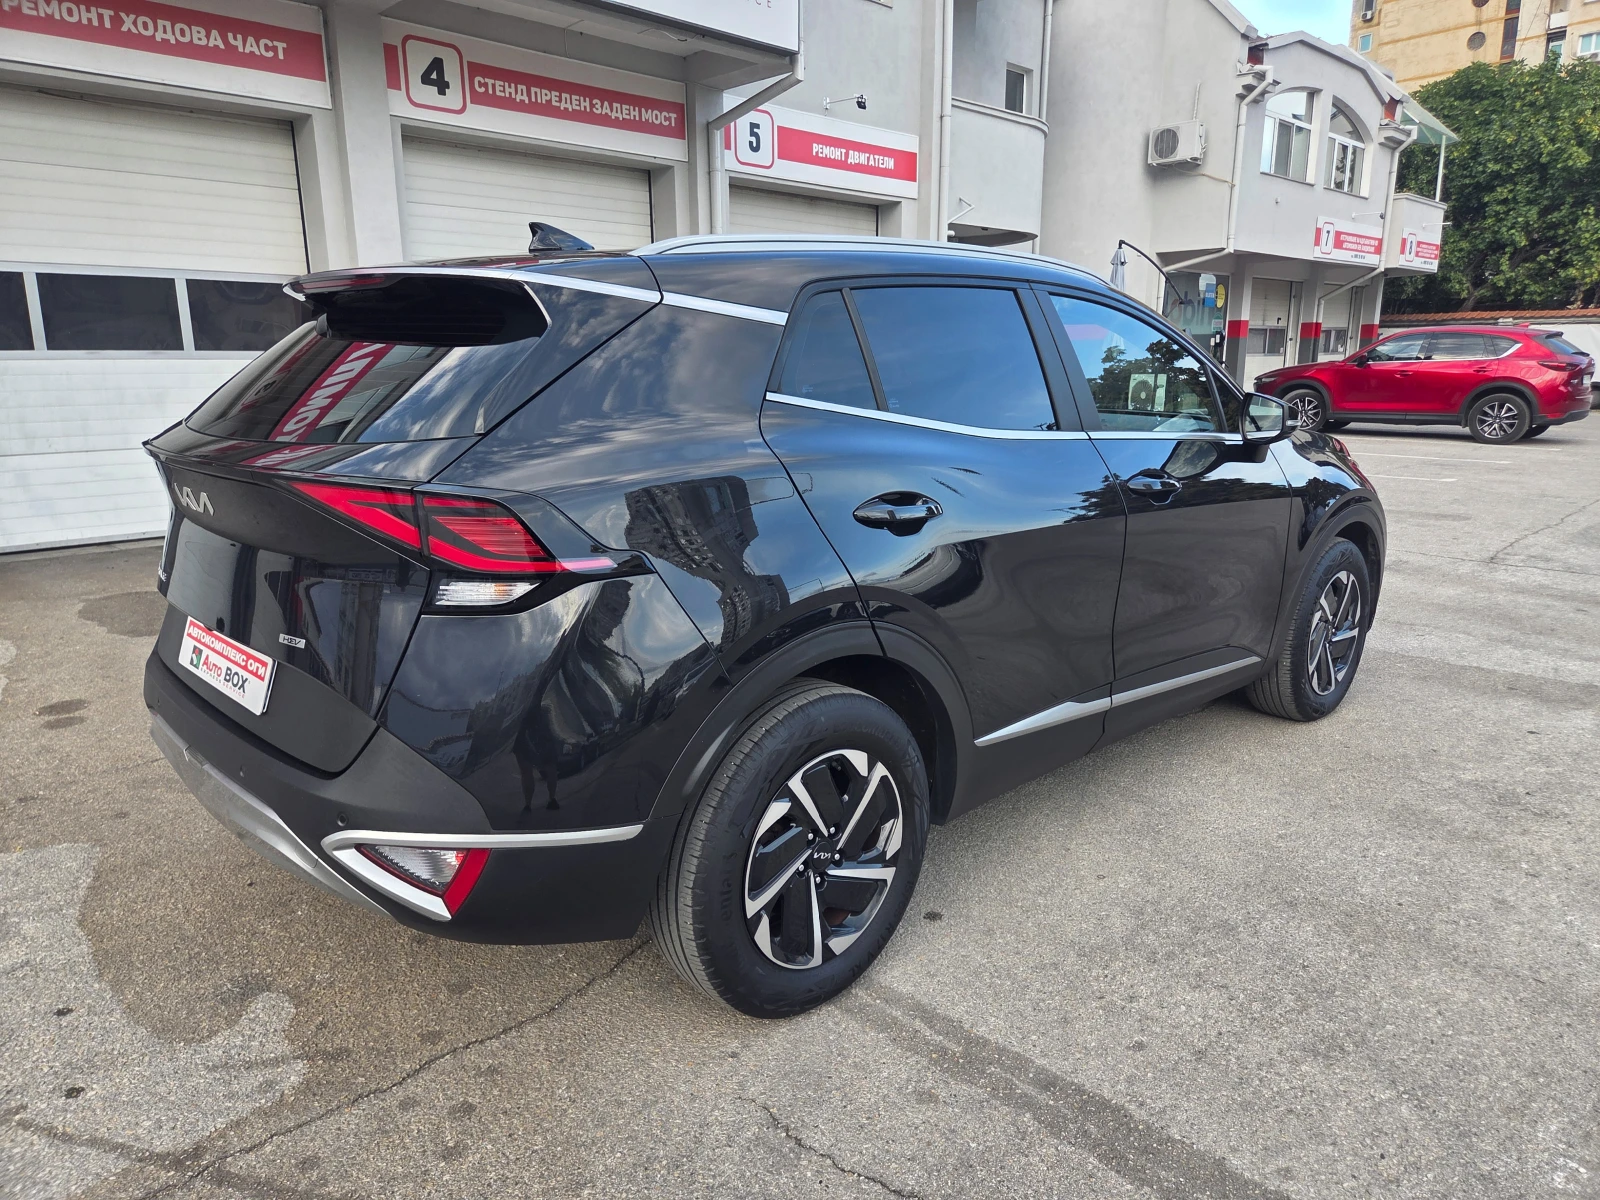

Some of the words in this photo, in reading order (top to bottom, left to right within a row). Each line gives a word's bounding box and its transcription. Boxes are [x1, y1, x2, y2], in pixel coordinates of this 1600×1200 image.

[2, 0, 114, 29] РЕМОНТ
[119, 11, 225, 50] ХОДОВА
[227, 32, 288, 60] ЧАСТ
[420, 56, 451, 97] 4
[474, 76, 529, 104] СТЕНД
[530, 86, 591, 112] ПРЕДЕН
[592, 98, 640, 121] ЗАДЕН
[641, 108, 677, 127] МОСТ
[748, 121, 761, 154] 5
[812, 143, 847, 162] РЕМОНТ
[847, 150, 895, 171] ДВИГАТЕЛИ
[174, 482, 215, 516] KIA
[188, 625, 247, 666] АВТОКОМПЛЕКС
[247, 659, 266, 678] ОГИ
[282, 635, 301, 647] HEV
[224, 665, 248, 694] BOX
